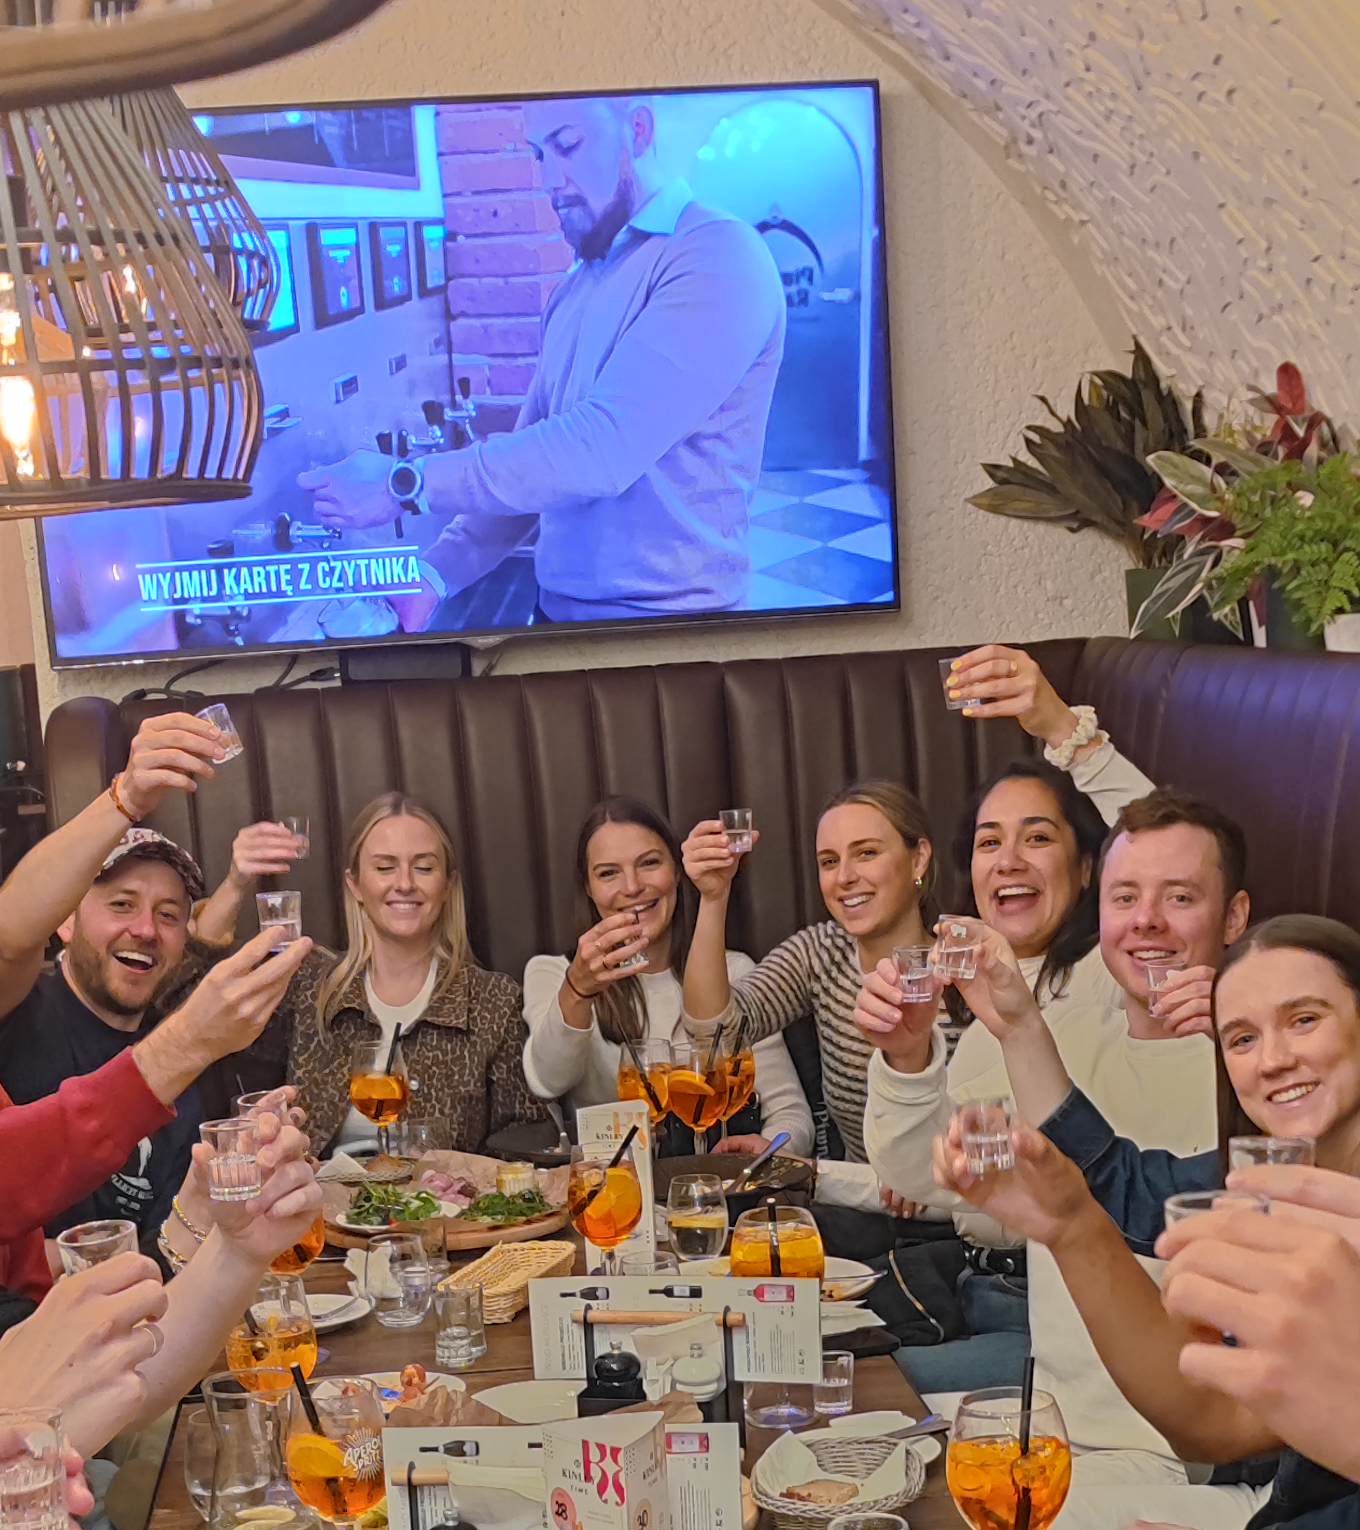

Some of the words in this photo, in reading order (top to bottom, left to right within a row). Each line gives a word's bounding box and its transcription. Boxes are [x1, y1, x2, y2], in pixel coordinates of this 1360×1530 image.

[138, 569, 218, 600] WYJMIJ
[224, 563, 293, 596] KARTĘ
[298, 563, 311, 590] Z
[317, 555, 421, 588] CZYTNIKA
[814, 1109, 830, 1157] Piwn
